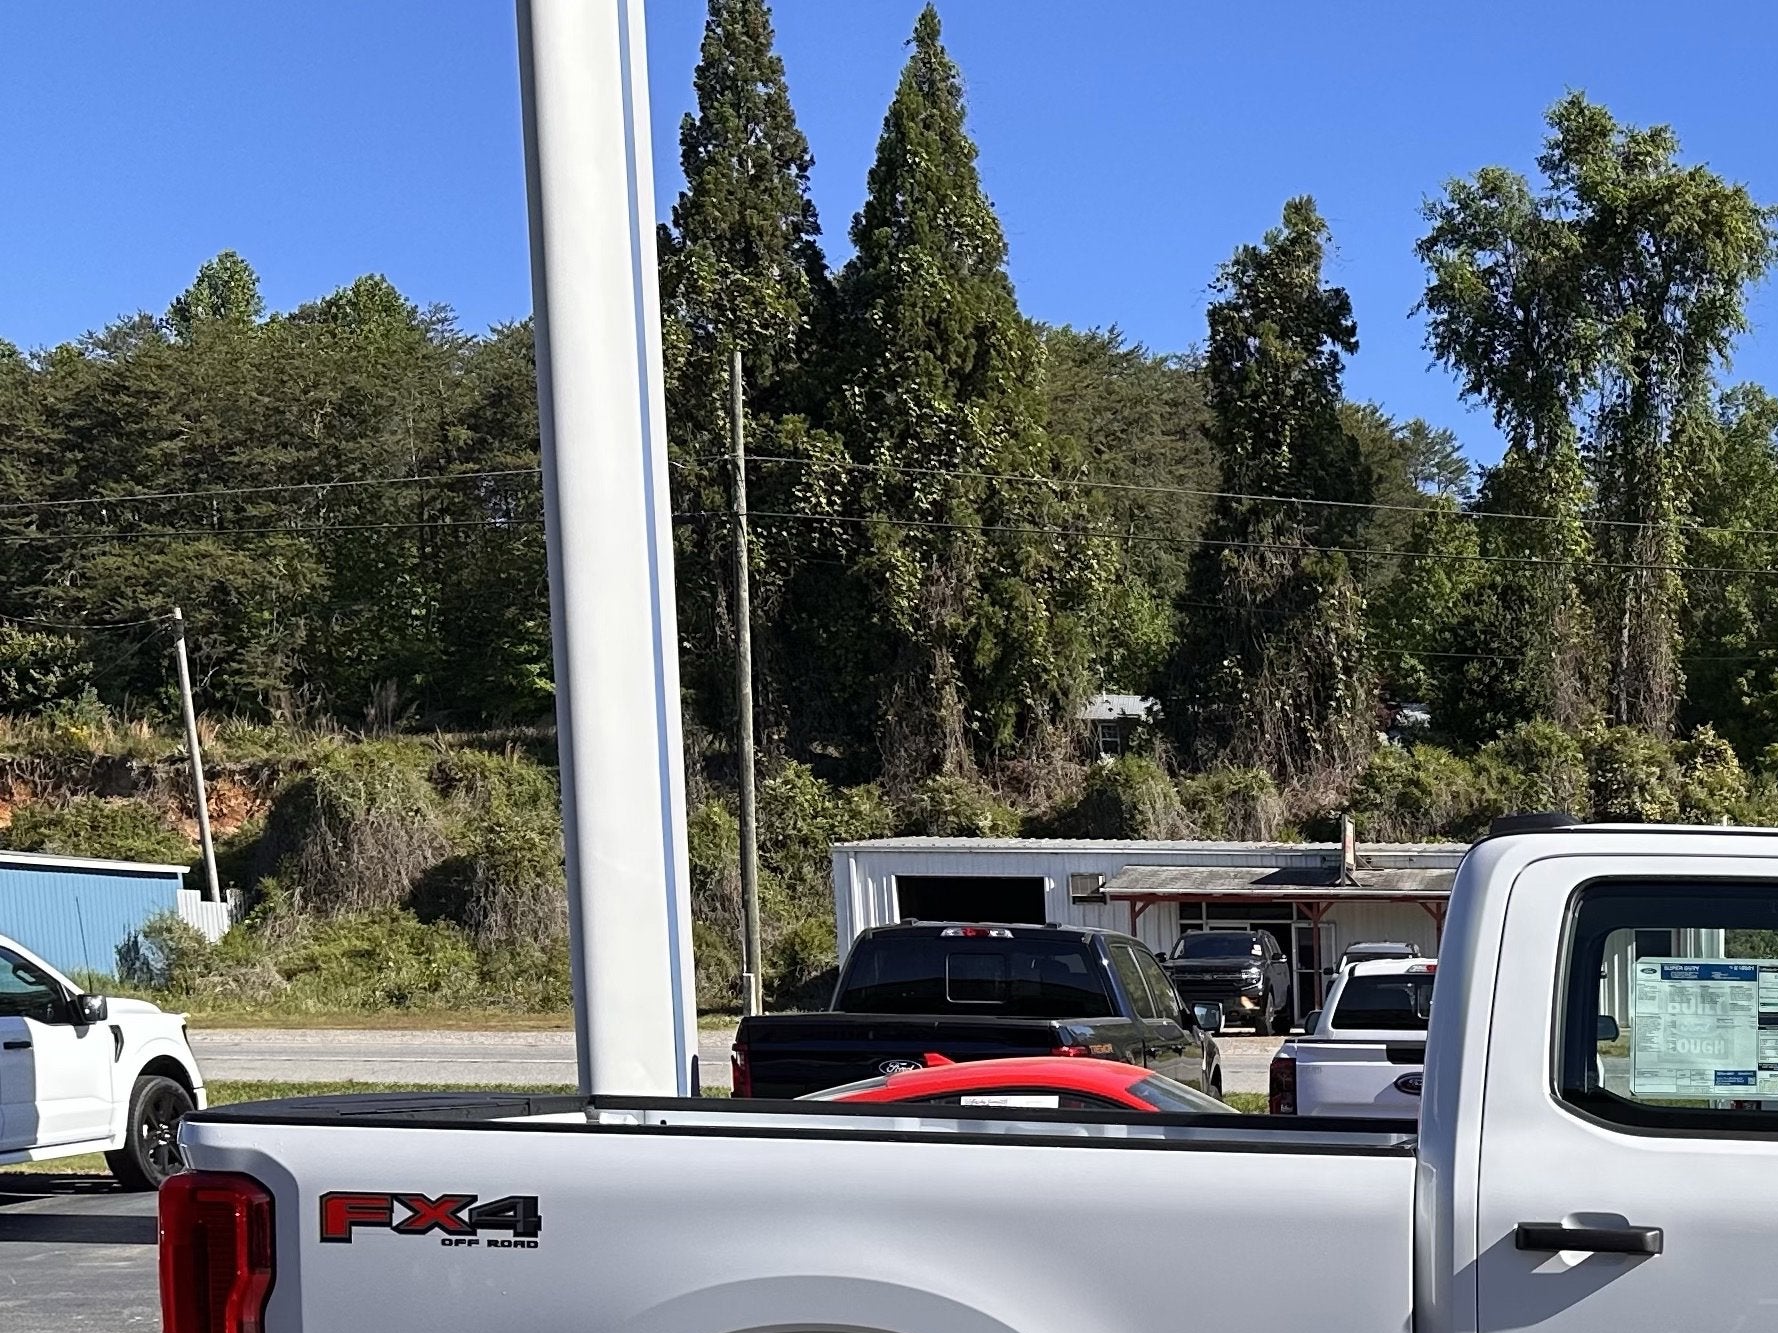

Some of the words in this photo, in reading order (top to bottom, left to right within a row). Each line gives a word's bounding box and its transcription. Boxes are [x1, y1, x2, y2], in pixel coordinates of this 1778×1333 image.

[320, 1191, 542, 1243] FX4
[440, 1238, 480, 1247] OFF
[486, 1239, 539, 1249] ROAD
